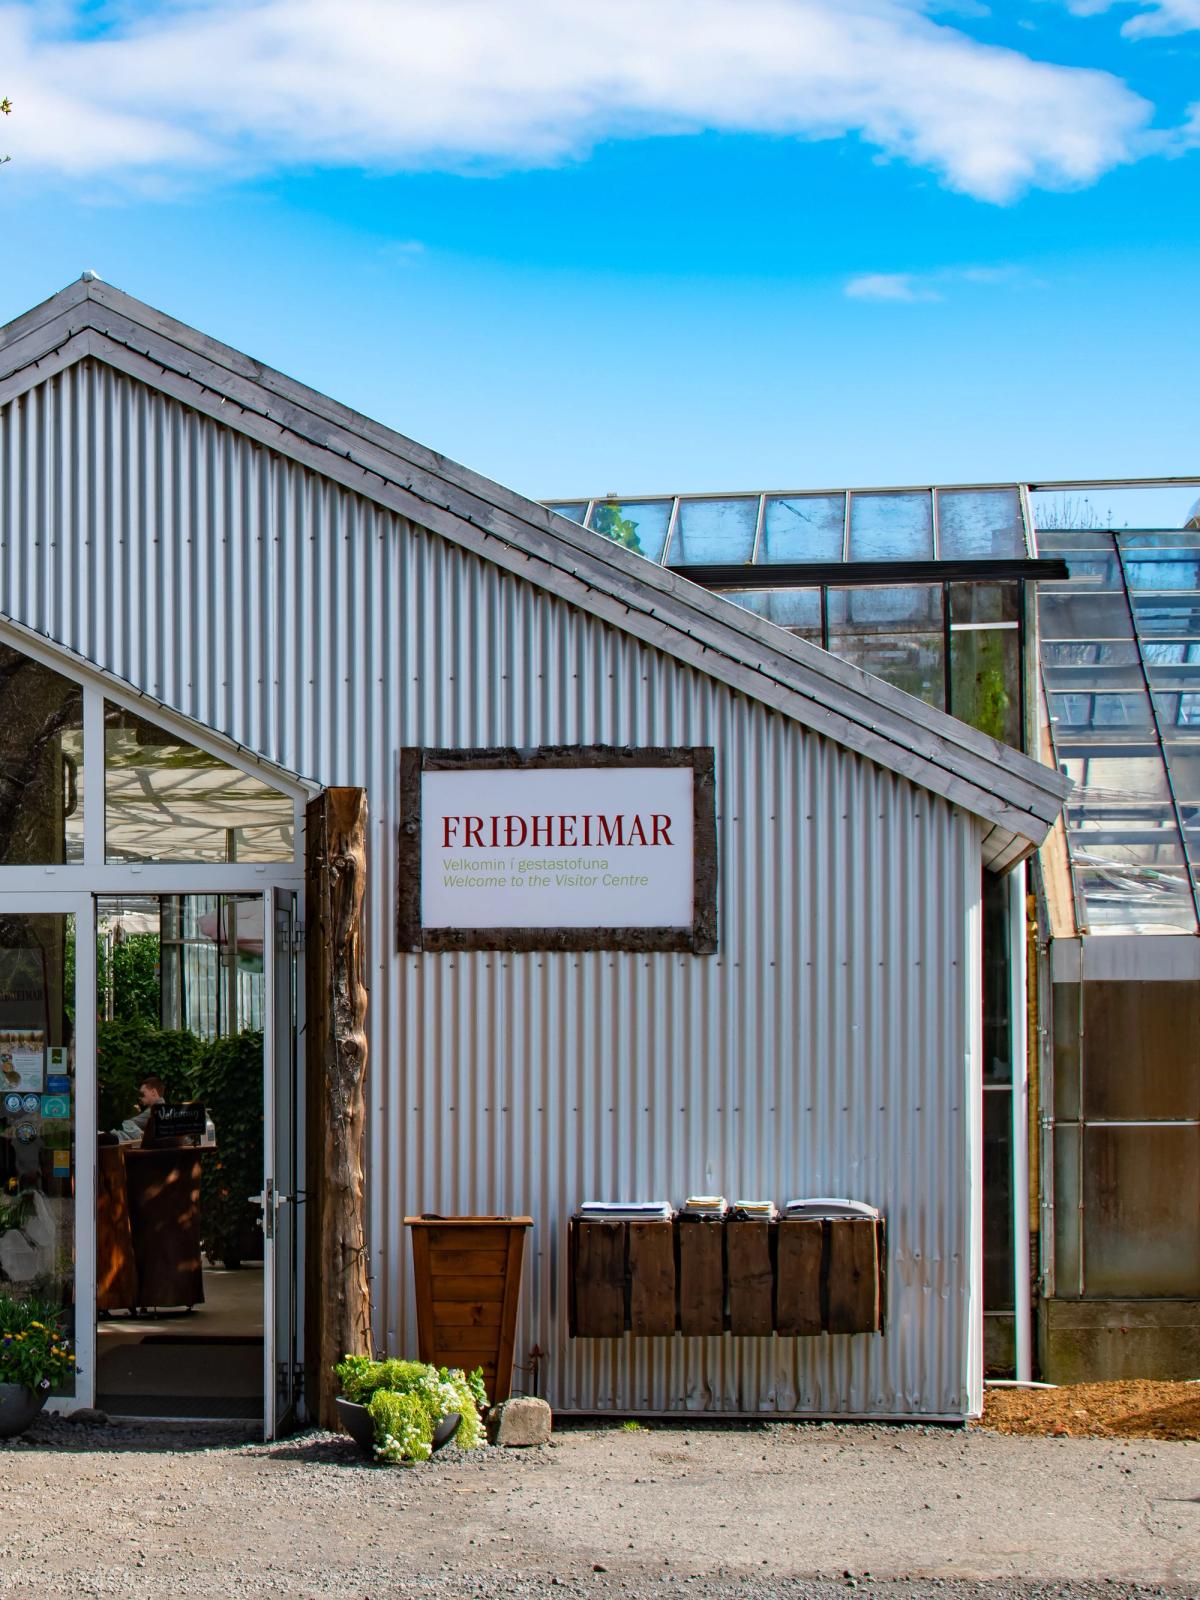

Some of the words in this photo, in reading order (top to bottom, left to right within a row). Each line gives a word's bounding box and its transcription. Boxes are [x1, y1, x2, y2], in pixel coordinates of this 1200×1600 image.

[441, 814, 675, 848] FRIÐHEIMAR
[443, 858, 505, 871] Velkomin
[518, 857, 609, 873] gestastofuna
[443, 875, 506, 888] Welcome
[511, 876, 524, 887] to
[528, 874, 550, 887] the
[556, 874, 598, 887] Visitor
[602, 873, 648, 887] Centre
